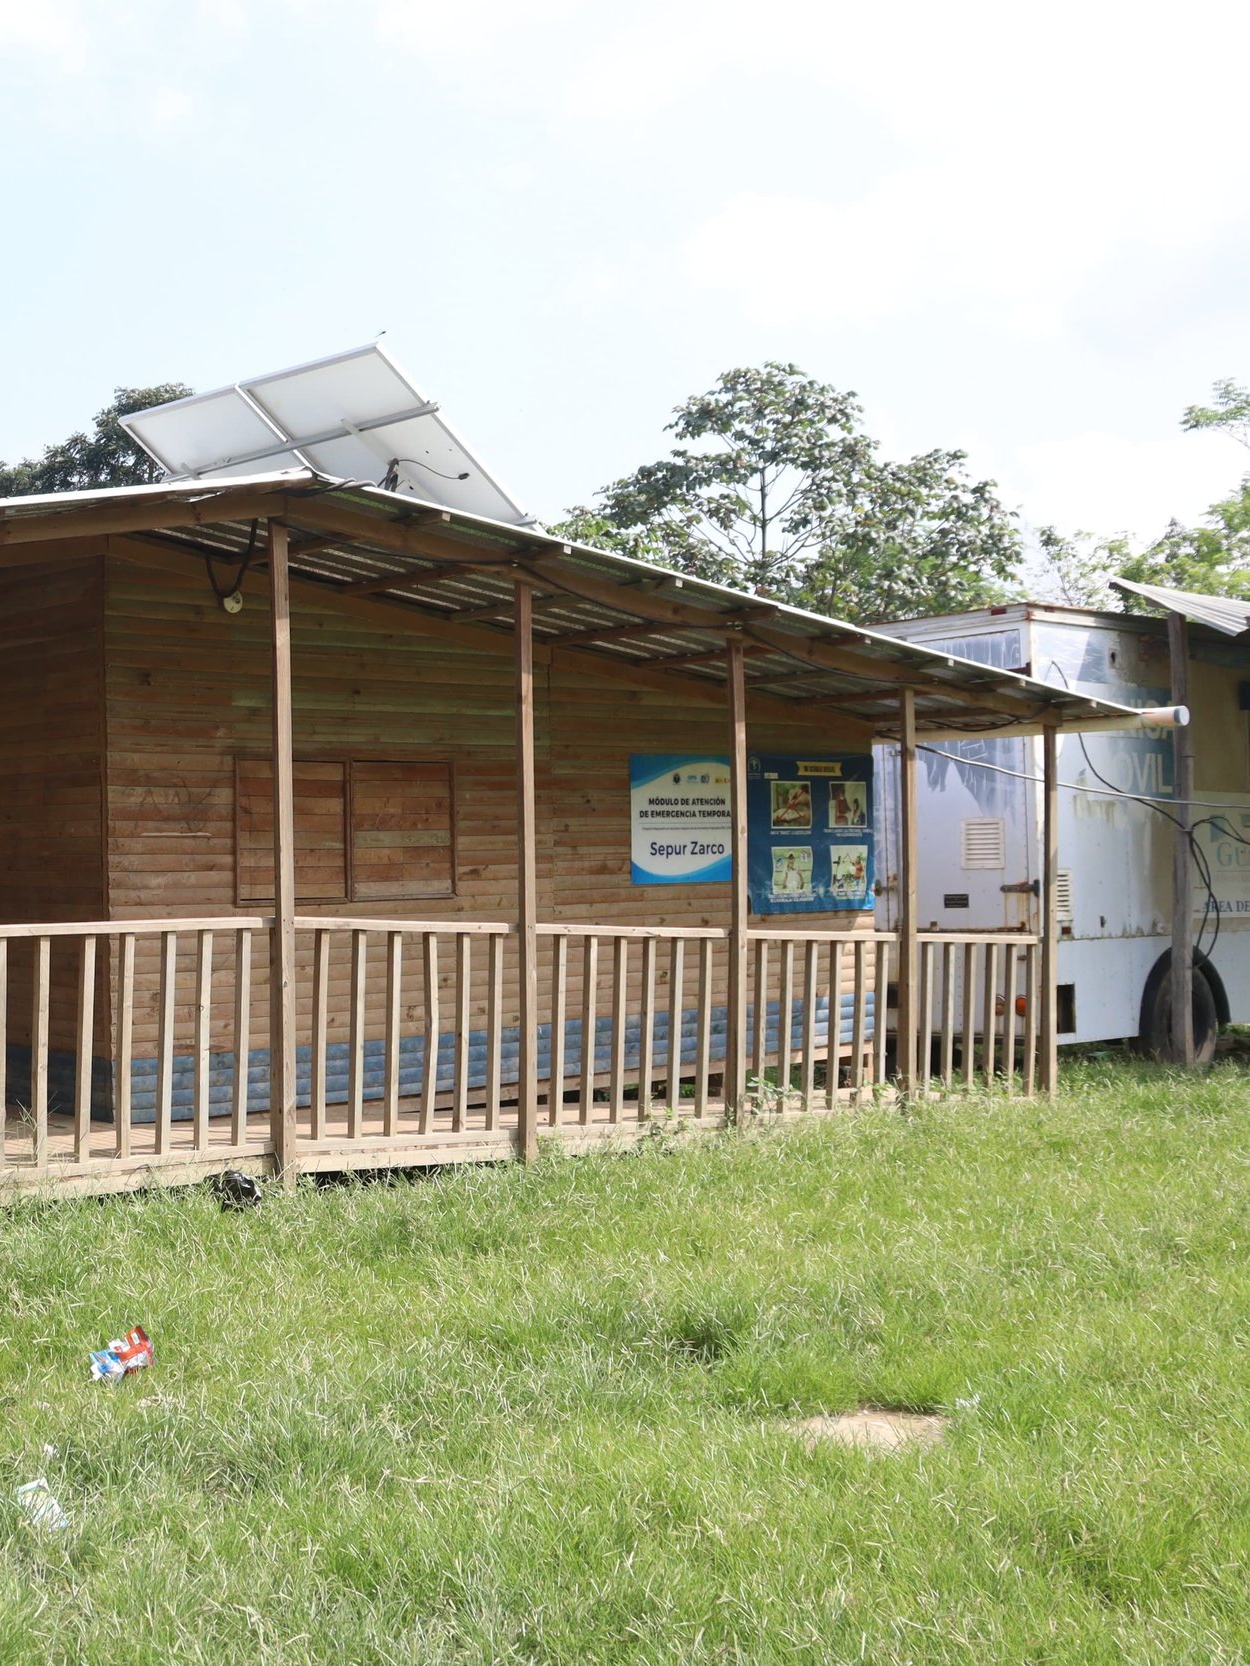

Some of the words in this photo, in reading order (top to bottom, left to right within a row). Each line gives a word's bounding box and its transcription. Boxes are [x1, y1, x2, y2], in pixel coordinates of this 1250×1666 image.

[648, 796, 679, 806] MÓDULO
[680, 797, 690, 806] DE
[691, 796, 726, 806] ATENCIÓN
[639, 810, 649, 818] DE
[651, 810, 697, 818] EMERGENCIA
[698, 810, 732, 818] TEMPORA
[650, 841, 687, 859] Sepur
[690, 841, 725, 856] Zarco
